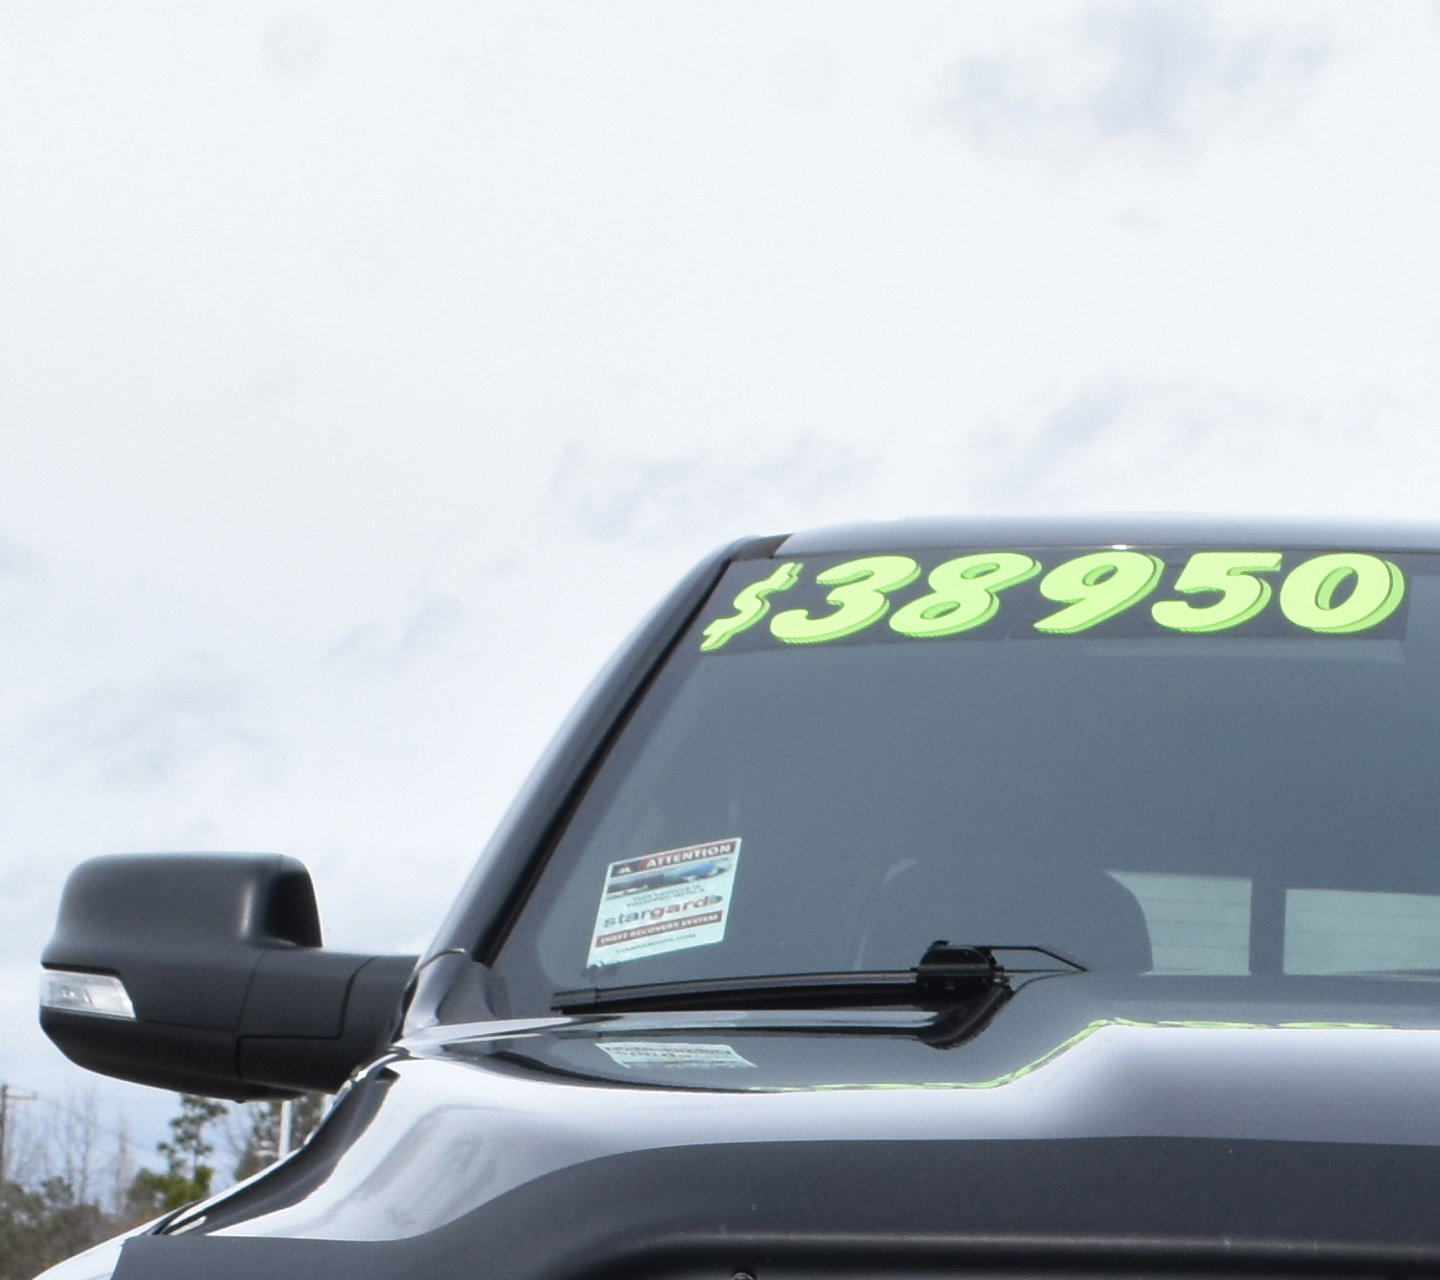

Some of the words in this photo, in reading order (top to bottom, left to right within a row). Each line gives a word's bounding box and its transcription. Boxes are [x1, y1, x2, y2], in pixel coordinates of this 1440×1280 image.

[700, 551, 1406, 652] $38950
[646, 843, 731, 868] ATTENTION
[603, 895, 711, 928] stargard
